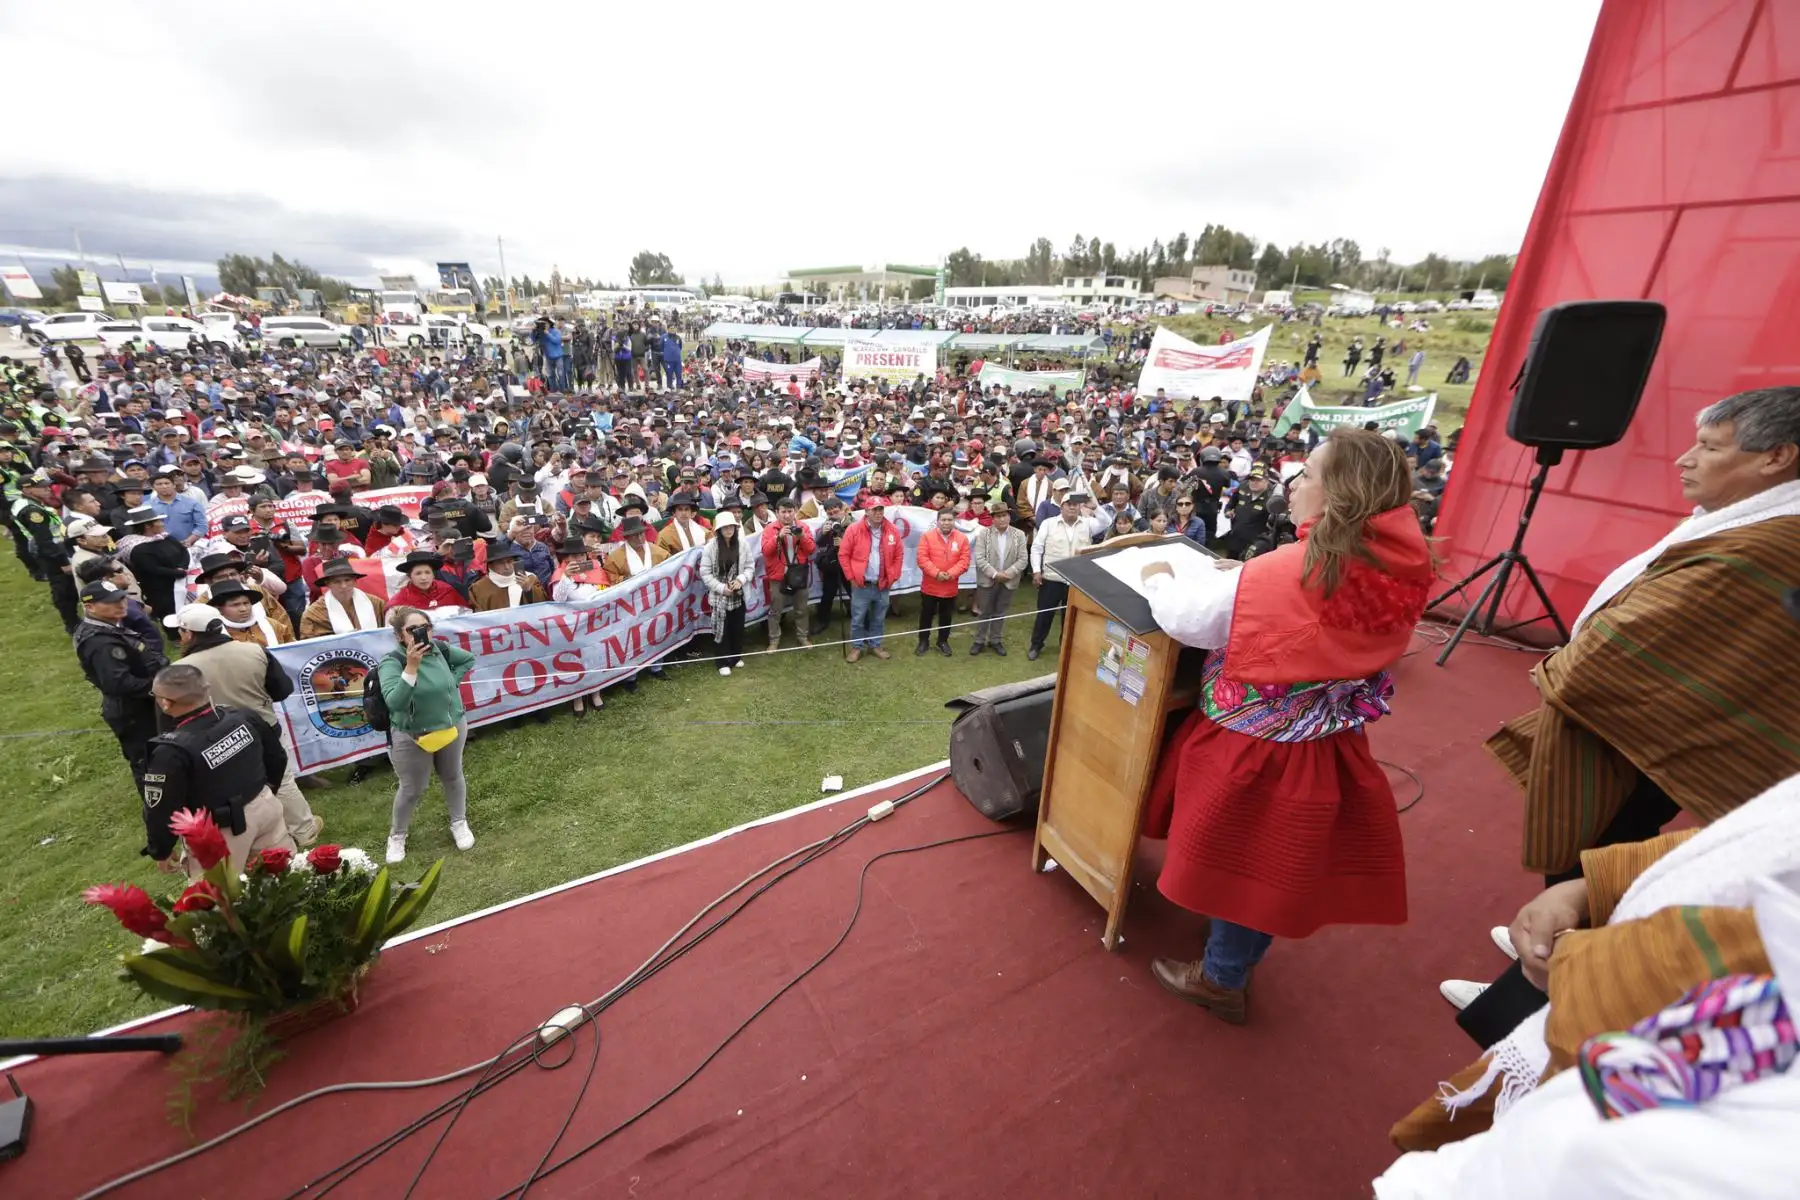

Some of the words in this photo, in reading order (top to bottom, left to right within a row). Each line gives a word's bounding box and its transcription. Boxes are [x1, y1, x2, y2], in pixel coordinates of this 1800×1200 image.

[856, 353, 921, 367] PRESENTE
[1333, 414, 1352, 422] DE
[274, 509, 317, 518] REGION
[432, 551, 702, 656] IENVENIDO
[301, 668, 316, 706] DISTRITO
[311, 650, 333, 667] LOS
[459, 648, 586, 712] LOS
[206, 729, 248, 760] ESCOLTA
[211, 738, 250, 766] PRESIDENCIAL
